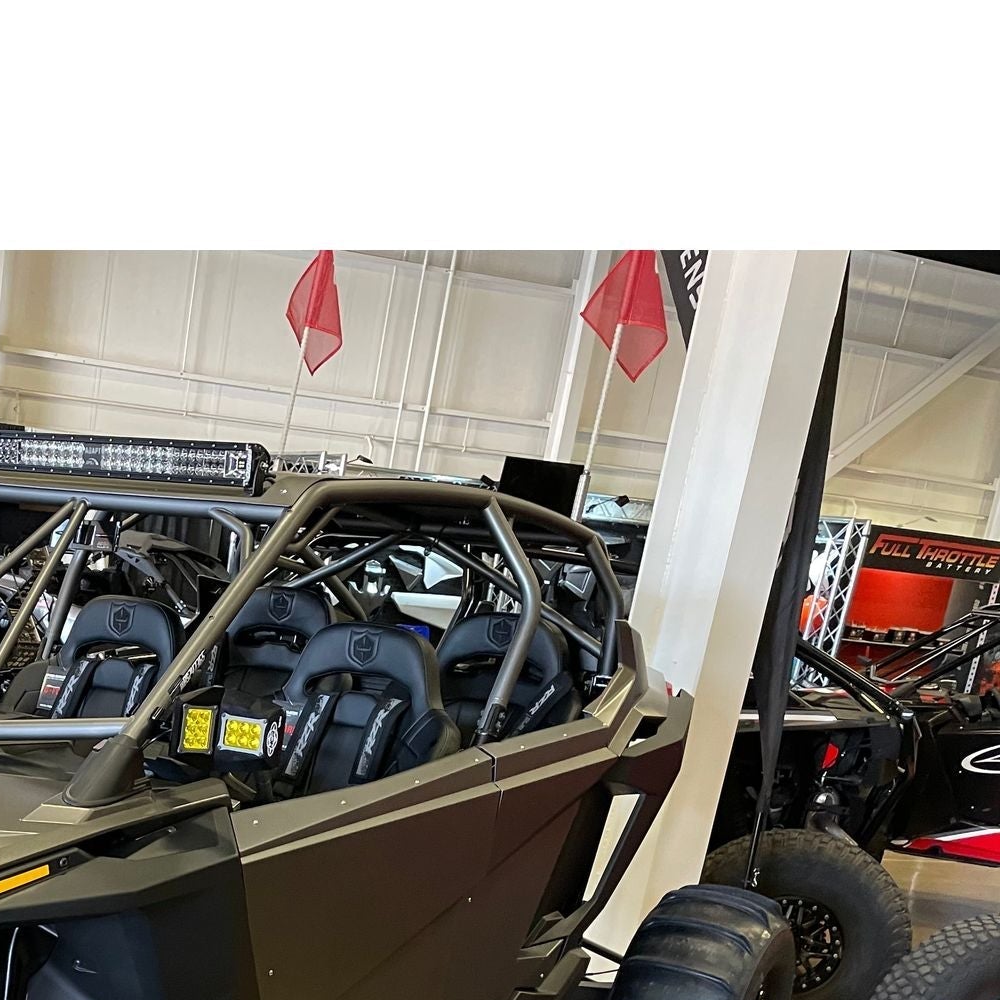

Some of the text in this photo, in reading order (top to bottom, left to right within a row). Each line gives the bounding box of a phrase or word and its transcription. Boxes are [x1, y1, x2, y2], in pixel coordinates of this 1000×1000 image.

[869, 534, 1000, 569] FULL THROTTLE
[926, 561, 992, 575] BATTERY
